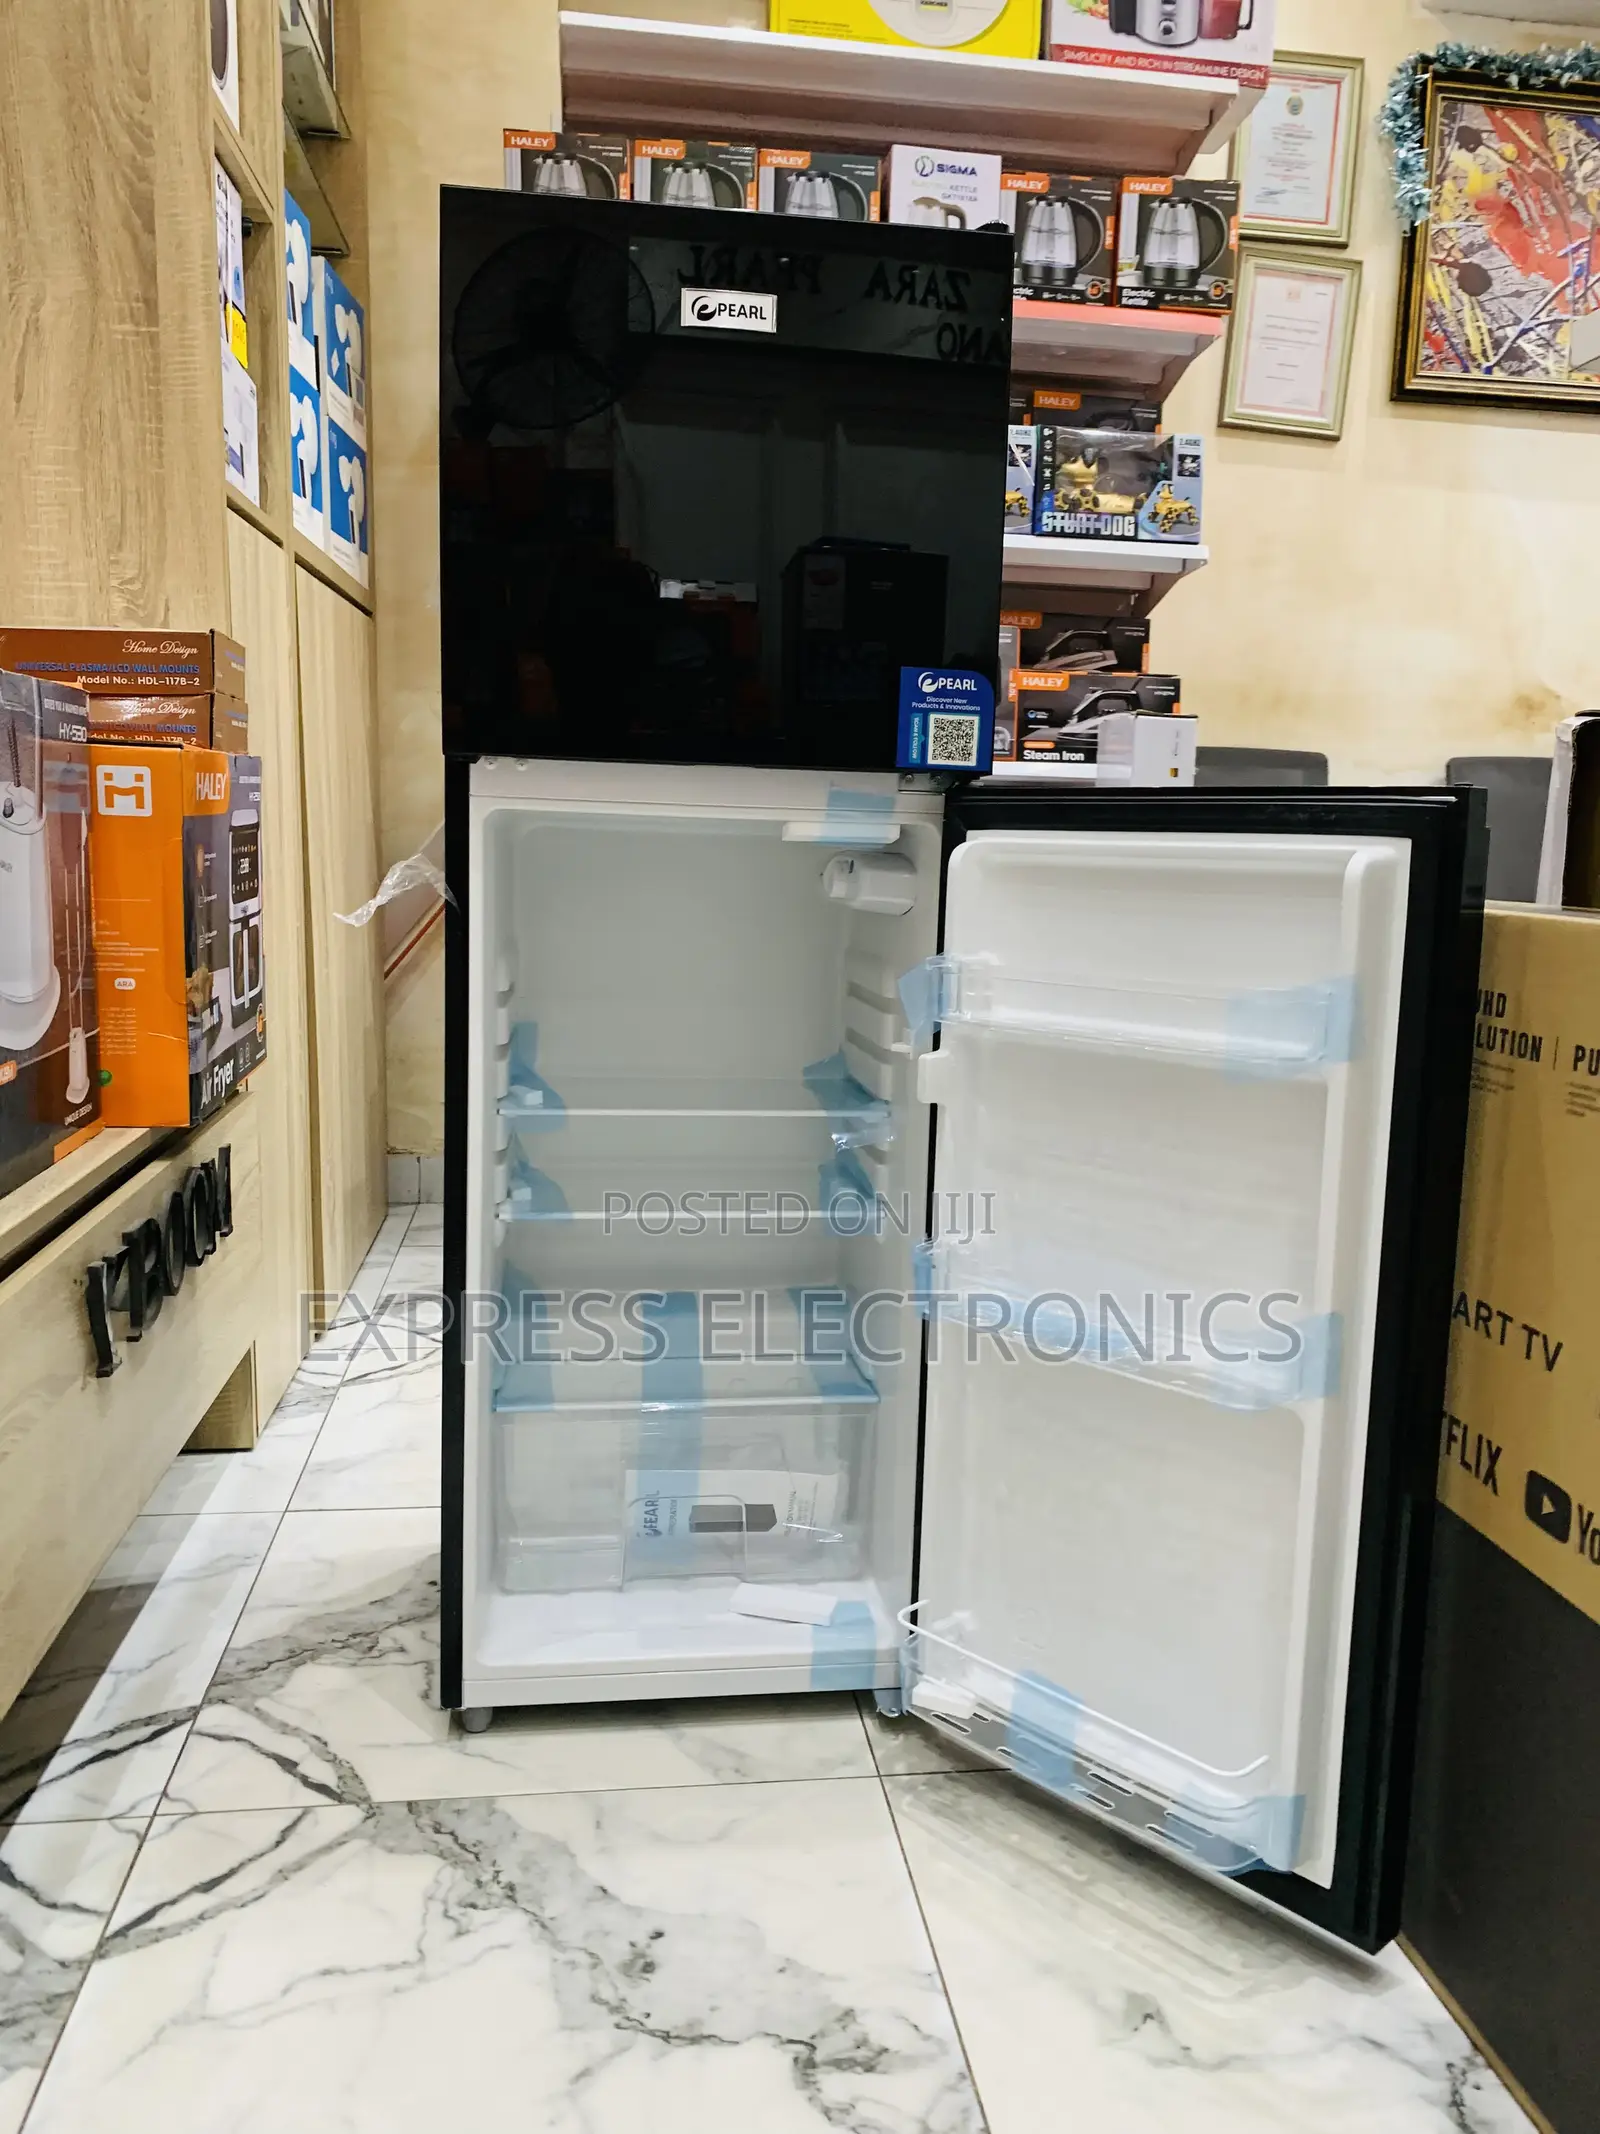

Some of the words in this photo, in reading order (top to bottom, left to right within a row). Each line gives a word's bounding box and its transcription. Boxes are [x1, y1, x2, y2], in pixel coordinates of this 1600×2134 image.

[1114, 56, 1138, 67] AND
[1230, 67, 1265, 80] DESIGN
[511, 136, 550, 147] HALEY
[642, 145, 680, 156] HALEY
[766, 155, 806, 166] HALEY
[936, 163, 977, 177] SIGMA
[1007, 179, 1045, 190] HALEY
[1129, 181, 1168, 192] HALEY
[1121, 288, 1156, 299] Electric
[718, 301, 767, 321] PEARL
[1039, 395, 1077, 407] HALEY
[122, 639, 158, 654] Home
[159, 640, 198, 659] Design
[15, 661, 68, 672] UNIVERSAL
[69, 662, 130, 674] PLASMA/LCD
[132, 663, 159, 673] WALL
[159, 664, 200, 674] MOUNTS
[77, 675, 109, 685] Model
[113, 676, 135, 685] No.:
[939, 677, 978, 691] PEARL
[1022, 676, 1064, 687] HALEY
[912, 701, 939, 709] Products
[157, 702, 196, 721] Design
[157, 724, 197, 734] MOUNTS
[1023, 749, 1060, 761] Steam
[1061, 750, 1085, 761] Iron
[196, 772, 227, 801] HALEY
[117, 980, 134, 988] ARA
[200, 1072, 213, 1110] Air
[213, 1058, 235, 1098] Fryer
[1451, 1291, 1514, 1347] ART
[1521, 1322, 1564, 1373] TV
